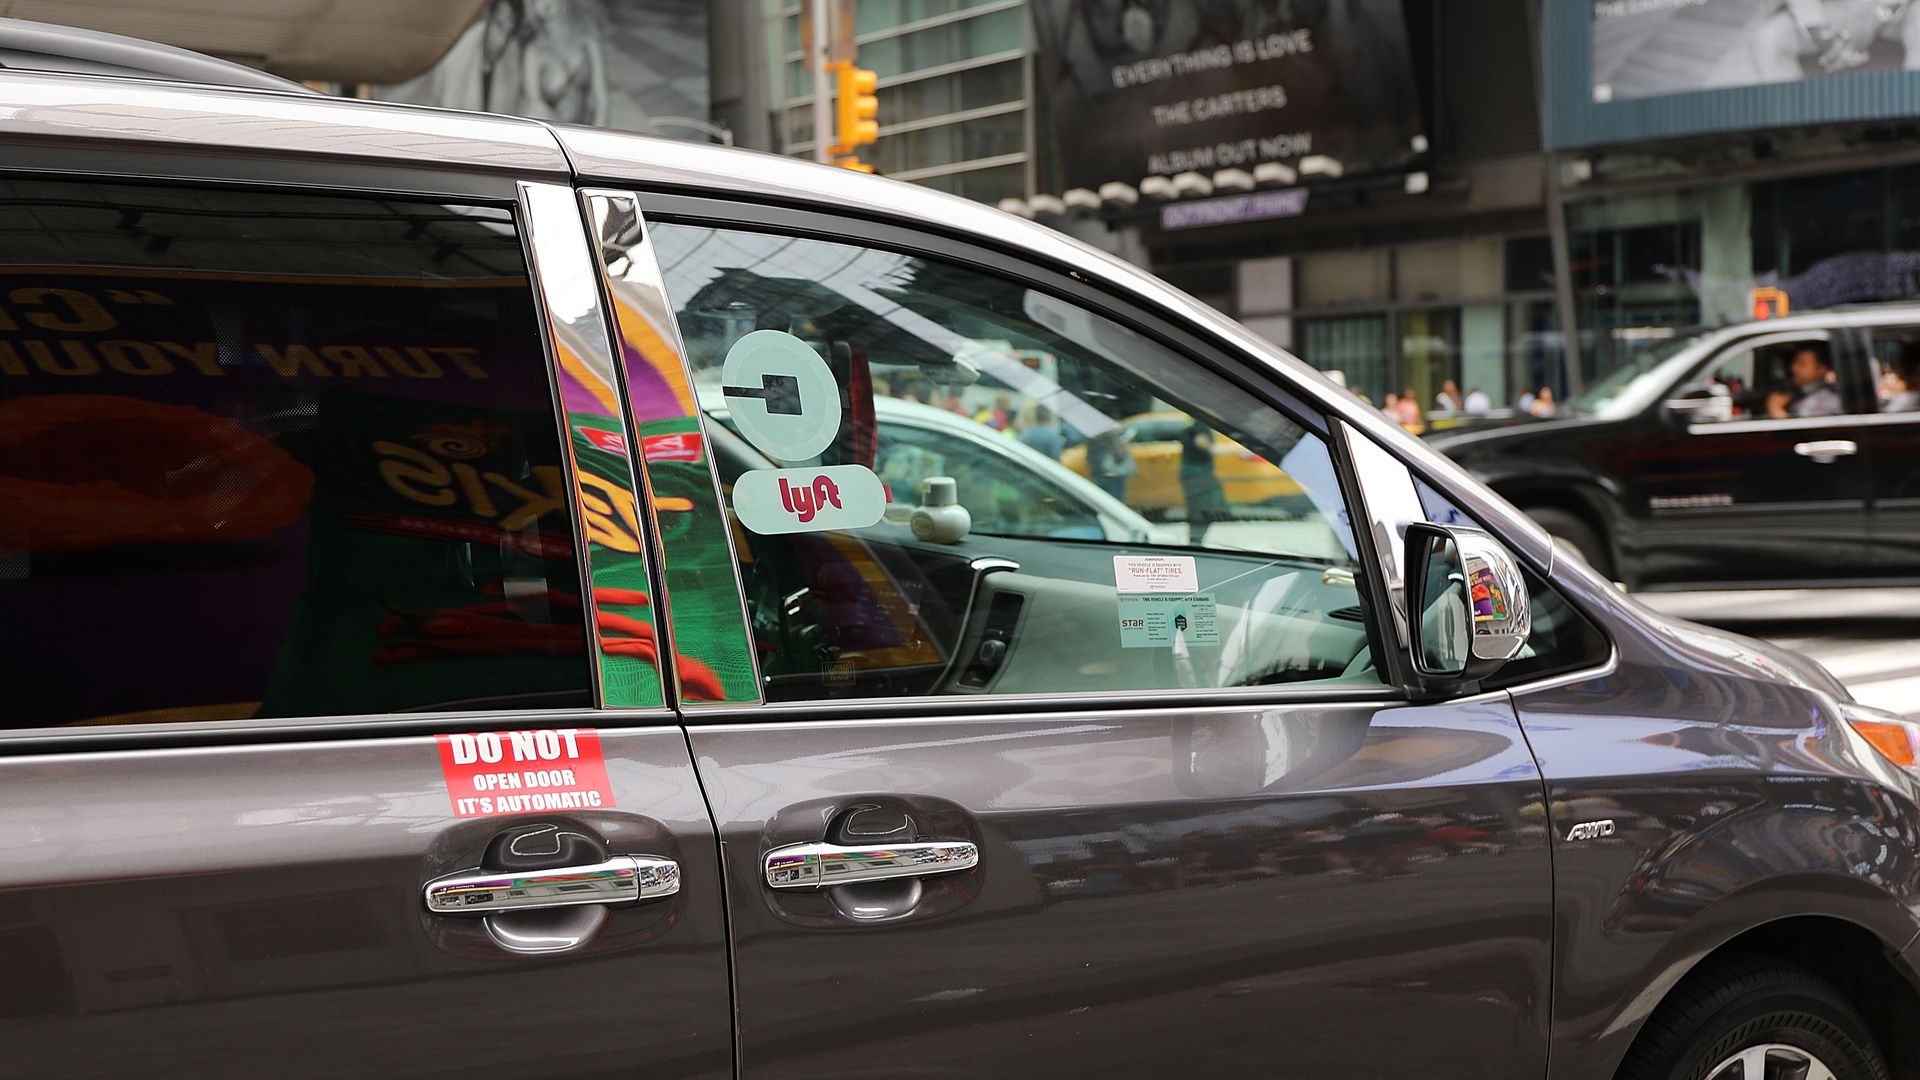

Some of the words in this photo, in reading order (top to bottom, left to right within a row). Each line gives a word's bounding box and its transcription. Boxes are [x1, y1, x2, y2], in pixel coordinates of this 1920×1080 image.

[1112, 44, 1233, 88] EVERYTHING
[1233, 39, 1256, 63] IS
[1256, 28, 1314, 60] LOVE
[1153, 100, 1192, 127] THE
[1191, 84, 1287, 121] CARTERS
[1148, 145, 1215, 174] ALBUM
[1215, 138, 1257, 166] OUT
[1259, 131, 1312, 159] NOW
[778, 474, 843, 523] lyft
[449, 732, 504, 765] DO
[509, 729, 580, 762] NOT
[473, 772, 522, 791] OPEN
[523, 769, 577, 788] DOOR
[457, 796, 494, 815] IT'S
[497, 790, 602, 813] AUTOMATIC
[1566, 819, 1616, 841] AWD
